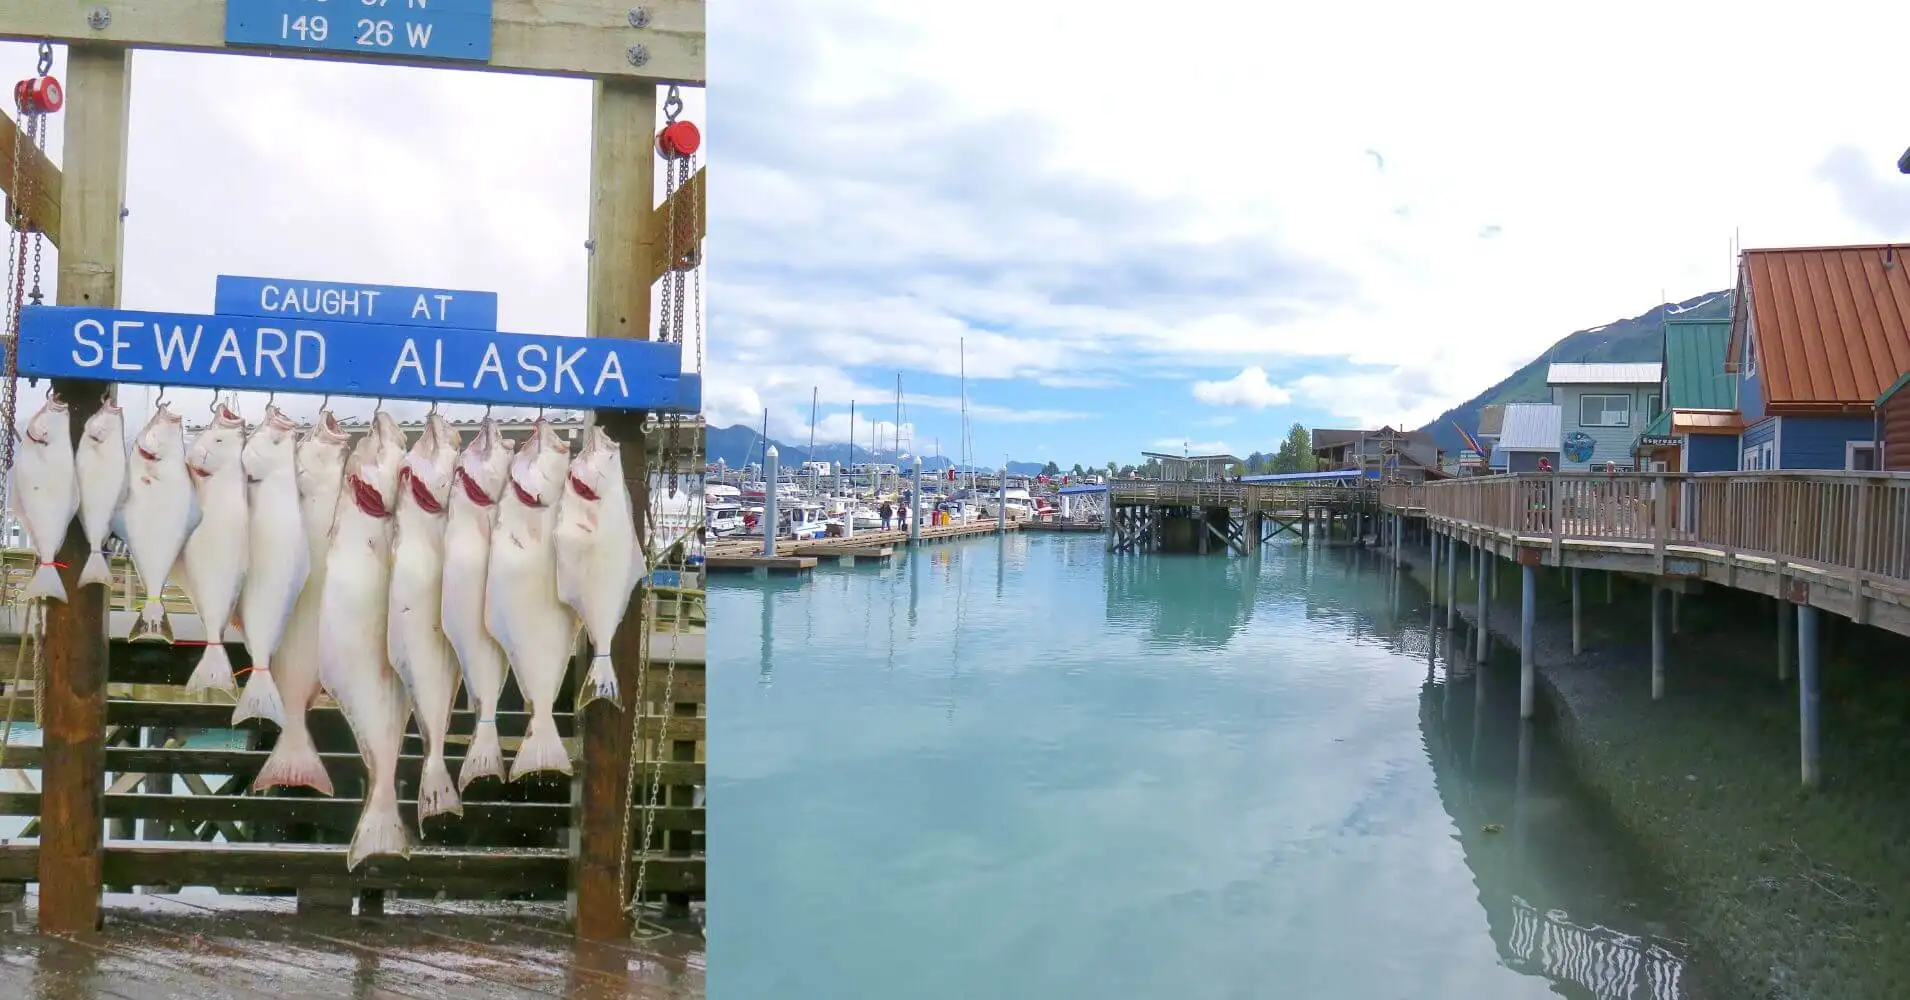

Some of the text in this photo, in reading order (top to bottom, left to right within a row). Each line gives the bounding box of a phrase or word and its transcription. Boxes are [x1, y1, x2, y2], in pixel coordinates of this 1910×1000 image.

[281, 14, 433, 49] 149 26 W
[260, 284, 454, 321] CAUGHT AT
[71, 319, 630, 398] SEWARD ALASKA
